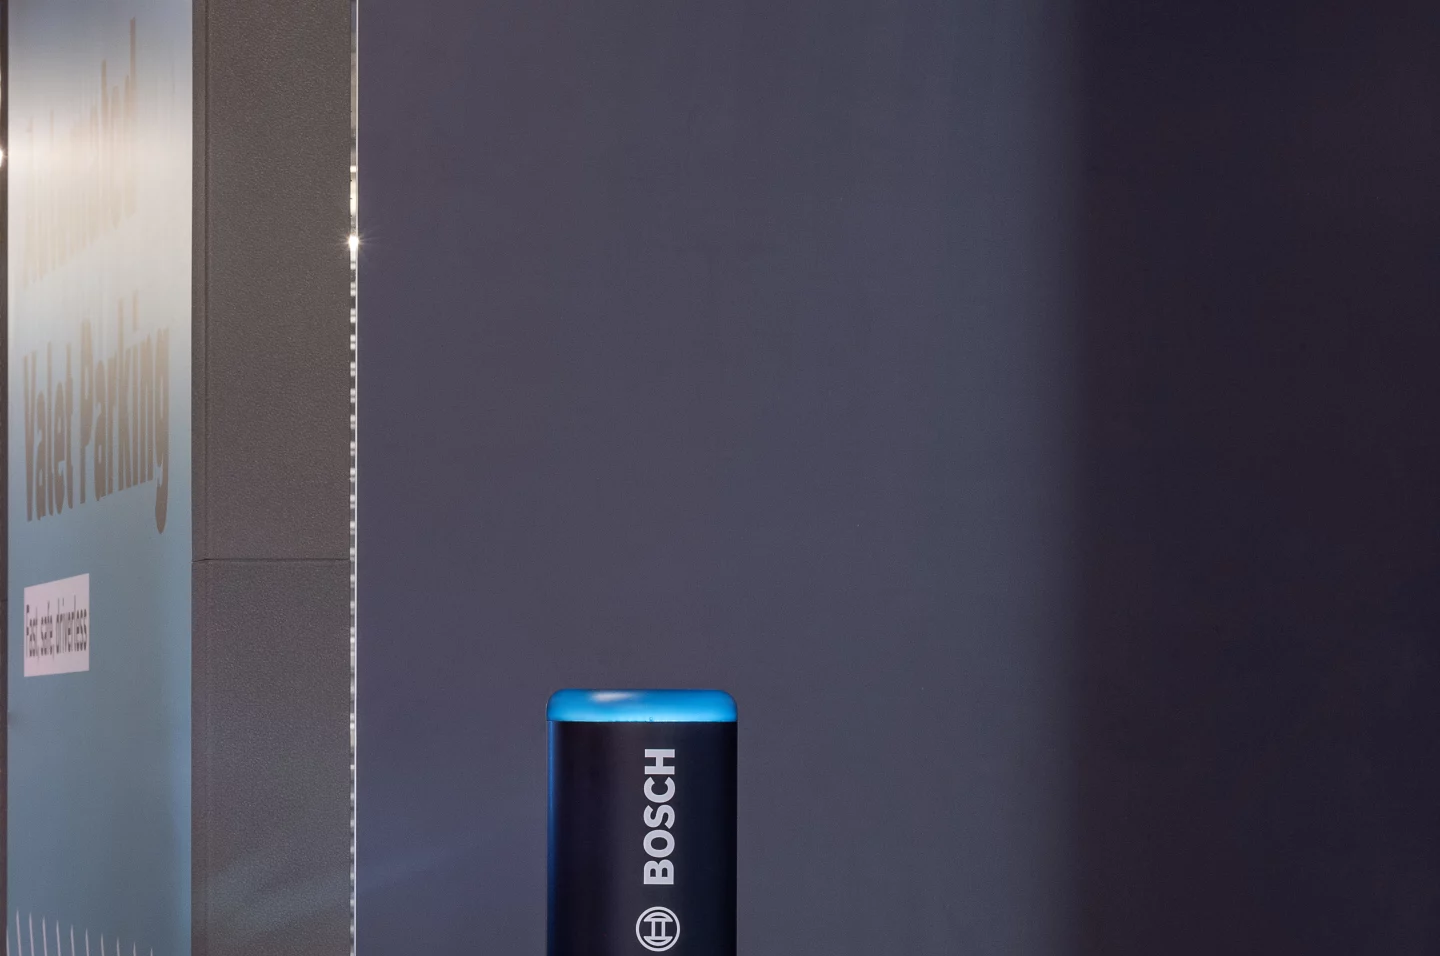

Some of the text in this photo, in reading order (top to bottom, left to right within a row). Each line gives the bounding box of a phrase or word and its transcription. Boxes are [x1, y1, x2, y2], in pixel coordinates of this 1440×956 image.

[23, 290, 169, 534] Valet Parking
[56, 595, 87, 654] driverless
[643, 749, 676, 885] BOSCH
